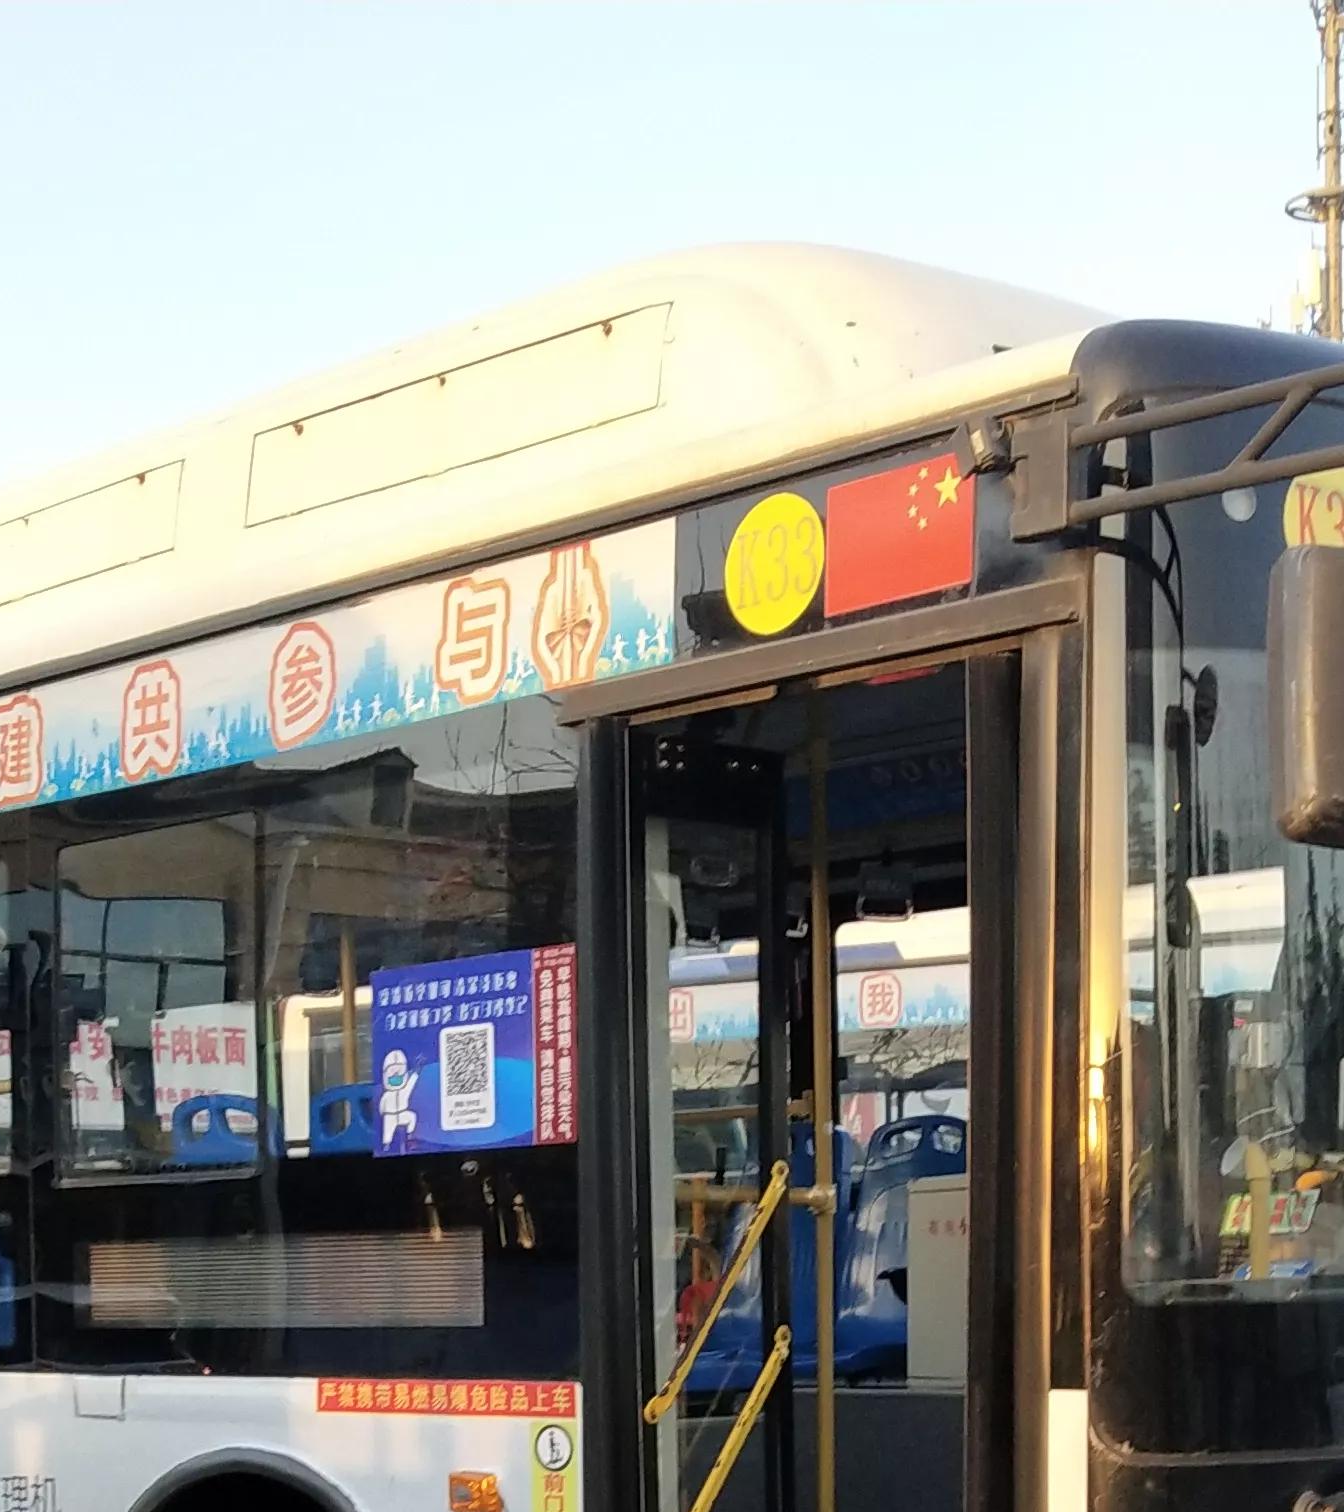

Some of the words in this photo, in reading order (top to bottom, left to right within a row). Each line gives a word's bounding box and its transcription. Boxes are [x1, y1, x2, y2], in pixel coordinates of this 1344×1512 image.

[736, 514, 821, 612] K33
[867, 981, 896, 1020] 我
[151, 1022, 248, 1067] 牛肉板面
[320, 1381, 573, 1414] 严禁携带易燃易爆危险品上车
